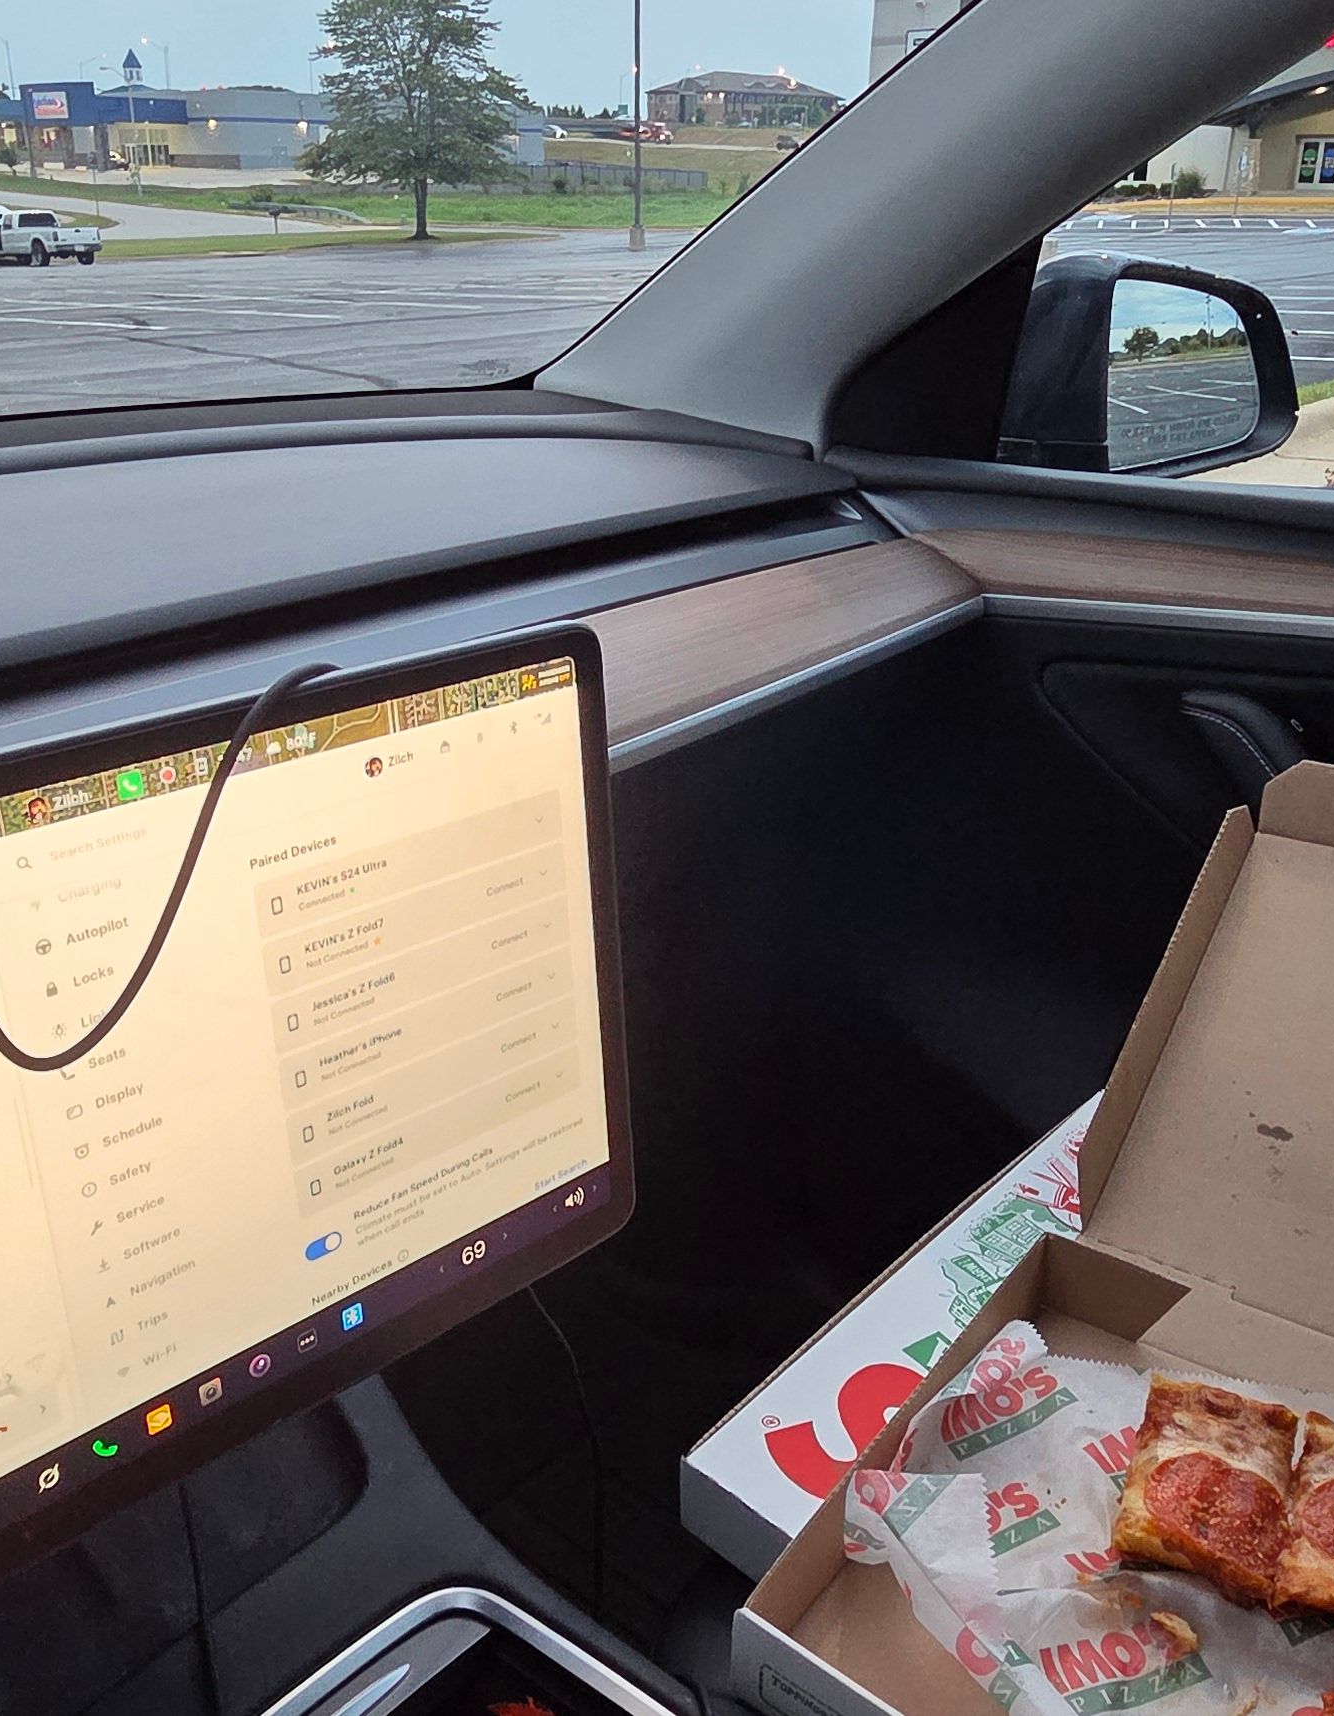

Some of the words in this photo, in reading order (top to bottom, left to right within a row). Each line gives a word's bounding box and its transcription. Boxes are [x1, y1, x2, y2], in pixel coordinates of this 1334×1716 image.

[388, 750, 414, 768] Zilch
[50, 841, 93, 862] Search
[96, 827, 148, 850] Settings
[249, 849, 288, 870] Paired
[291, 835, 337, 858] Devices
[58, 877, 122, 903] Charging
[296, 874, 339, 896] KEVIN's
[340, 867, 361, 882] S24
[362, 858, 388, 874] Ultra
[486, 876, 525, 898] Connect
[298, 889, 346, 911] Connected
[66, 915, 129, 946] Autopilot
[304, 933, 346, 955] KEVIN's
[347, 928, 355, 939] Z
[356, 917, 384, 936] Fold7
[491, 929, 528, 951] Connect
[306, 957, 323, 970] Not
[324, 940, 370, 963] Connected
[73, 966, 115, 988] Locks
[312, 987, 358, 1012] Jessica's
[359, 983, 367, 994] Z
[367, 971, 396, 990] Fold6
[495, 981, 533, 1002] Connect
[313, 1014, 329, 1027] Not
[330, 996, 375, 1021] Connected
[318, 1041, 367, 1067] Heather's
[368, 1027, 402, 1048] iPhone
[500, 1031, 538, 1053] Connect
[88, 1048, 126, 1069] Seats
[320, 1070, 336, 1083] Not
[337, 1051, 382, 1077] Connected
[95, 1083, 144, 1109] Display
[504, 1081, 542, 1103] Connect
[326, 1104, 351, 1122] Zilch
[352, 1094, 375, 1112] Fold
[327, 1123, 343, 1136] Not
[344, 1104, 388, 1130] Connected
[102, 1116, 163, 1147] Schedule
[333, 1157, 367, 1176] Galaxy
[368, 1149, 376, 1161] Z
[376, 1136, 404, 1156] Fold4
[108, 1161, 152, 1186] Safety
[334, 1177, 350, 1190] Not
[351, 1156, 395, 1183] Connected
[353, 1199, 390, 1220] Reduce
[391, 1186, 409, 1201] Fan
[410, 1172, 440, 1194] Speed
[440, 1157, 471, 1180] During
[471, 1146, 493, 1163] Calls
[355, 1212, 392, 1235] Climate
[394, 1199, 418, 1216] must
[419, 1190, 431, 1204] be
[432, 1185, 448, 1199] set
[448, 1179, 459, 1190] to
[485, 1148, 521, 1172] Settings
[549, 1117, 584, 1141] restored
[533, 1175, 556, 1192] Start
[557, 1158, 588, 1179] Search
[116, 1195, 165, 1223] Service
[123, 1228, 181, 1260] Software
[460, 1239, 487, 1265] 69
[130, 1259, 196, 1296] Navigation
[311, 1281, 350, 1306] Nearby
[352, 1259, 394, 1284] Devices
[137, 1311, 169, 1331] Trips
[142, 1342, 177, 1366] Wi-Fi
[955, 1392, 1071, 1457] PIZZA
